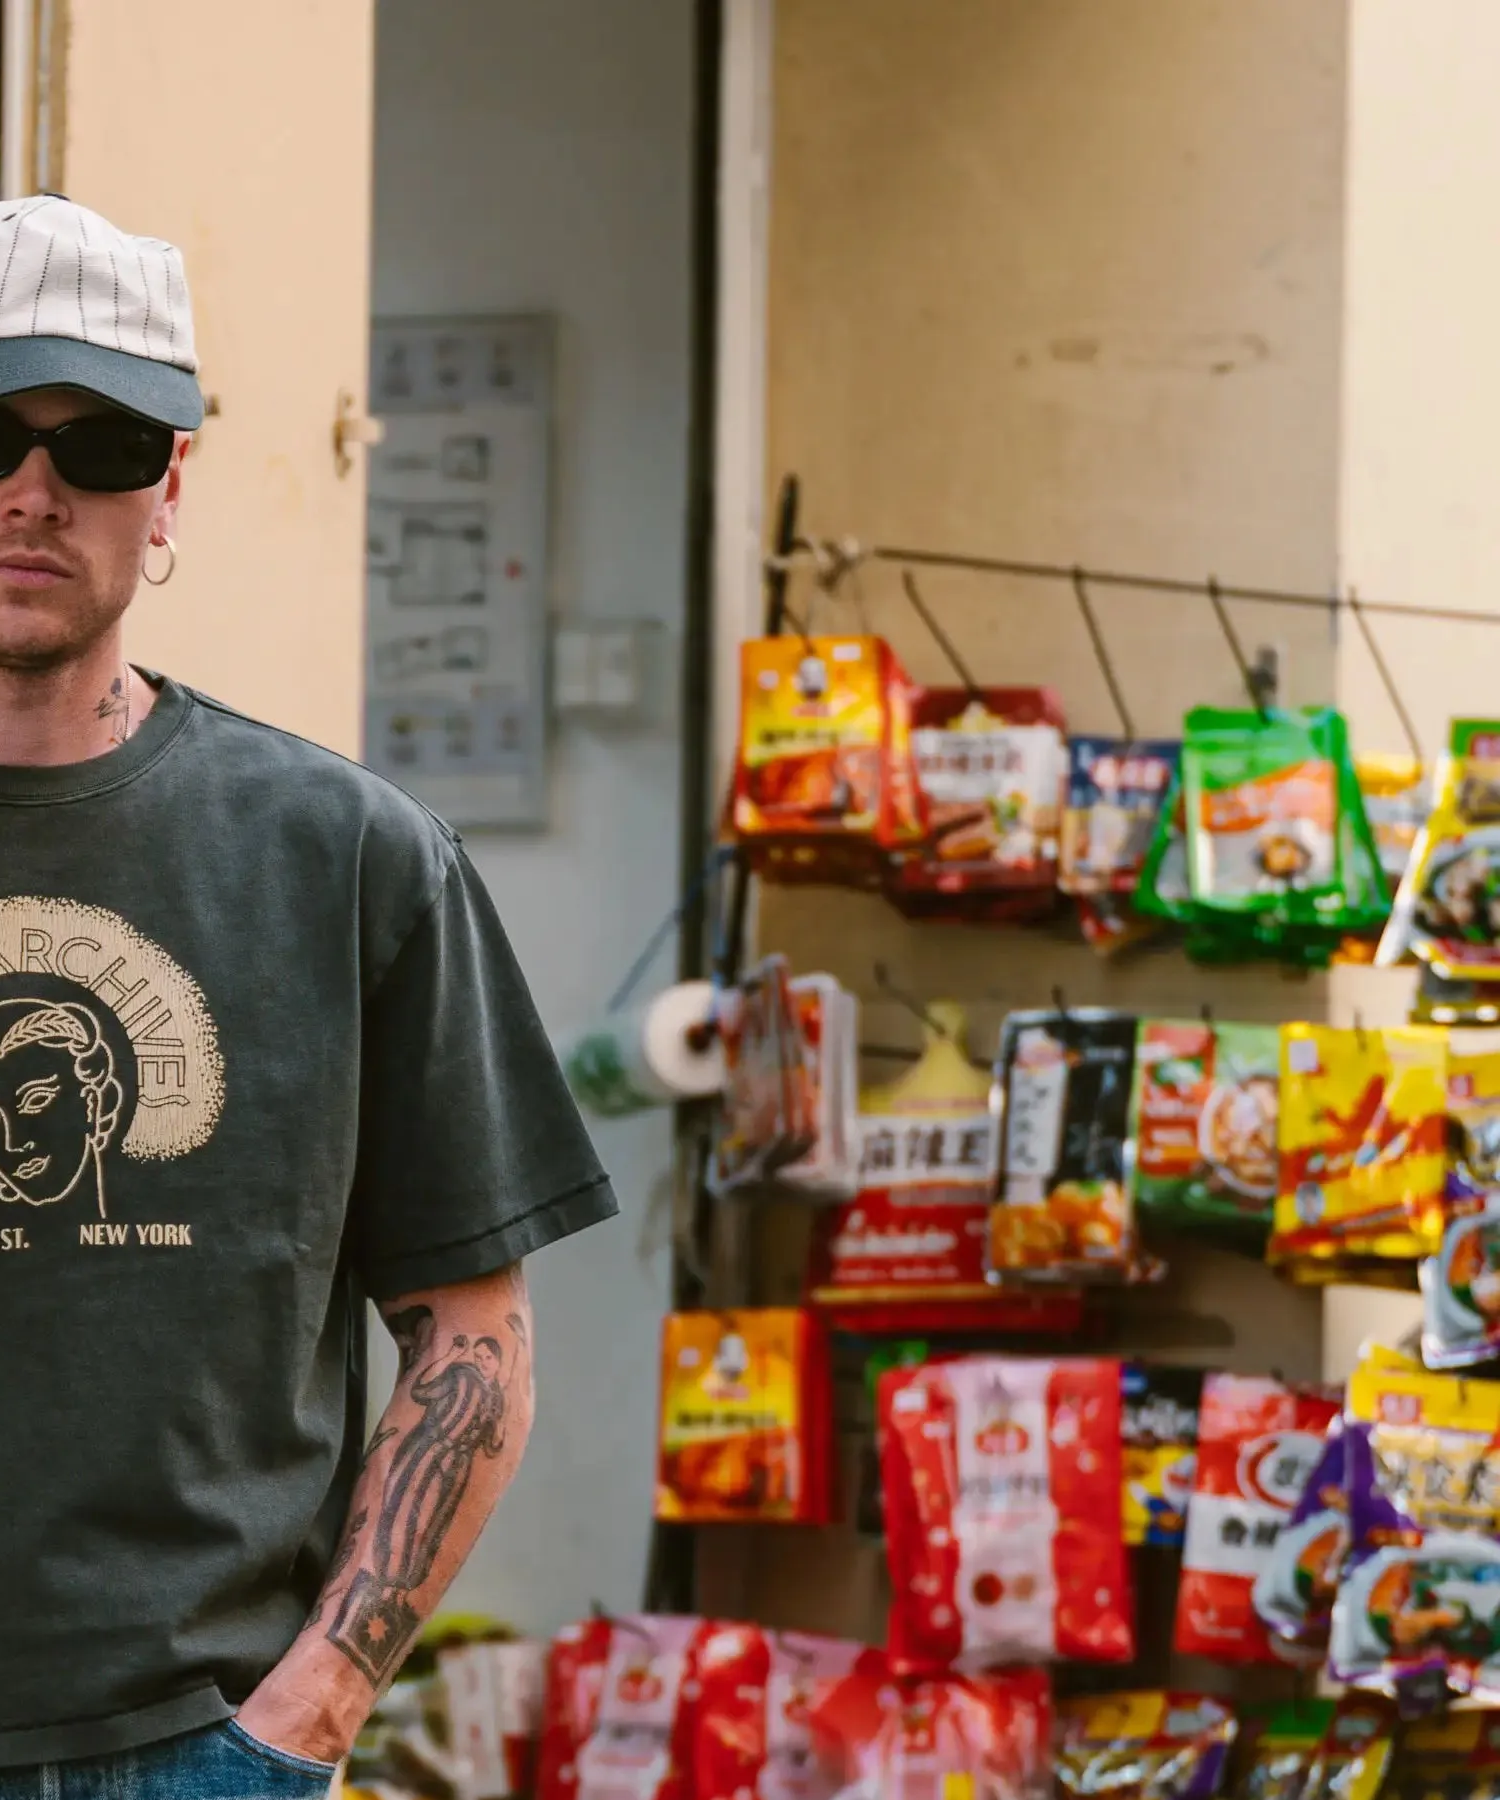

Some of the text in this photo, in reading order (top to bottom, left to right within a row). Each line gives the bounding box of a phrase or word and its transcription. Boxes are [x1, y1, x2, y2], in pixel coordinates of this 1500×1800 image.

[0, 1227, 30, 1250] ST.
[79, 1223, 192, 1247] NEW YORK
